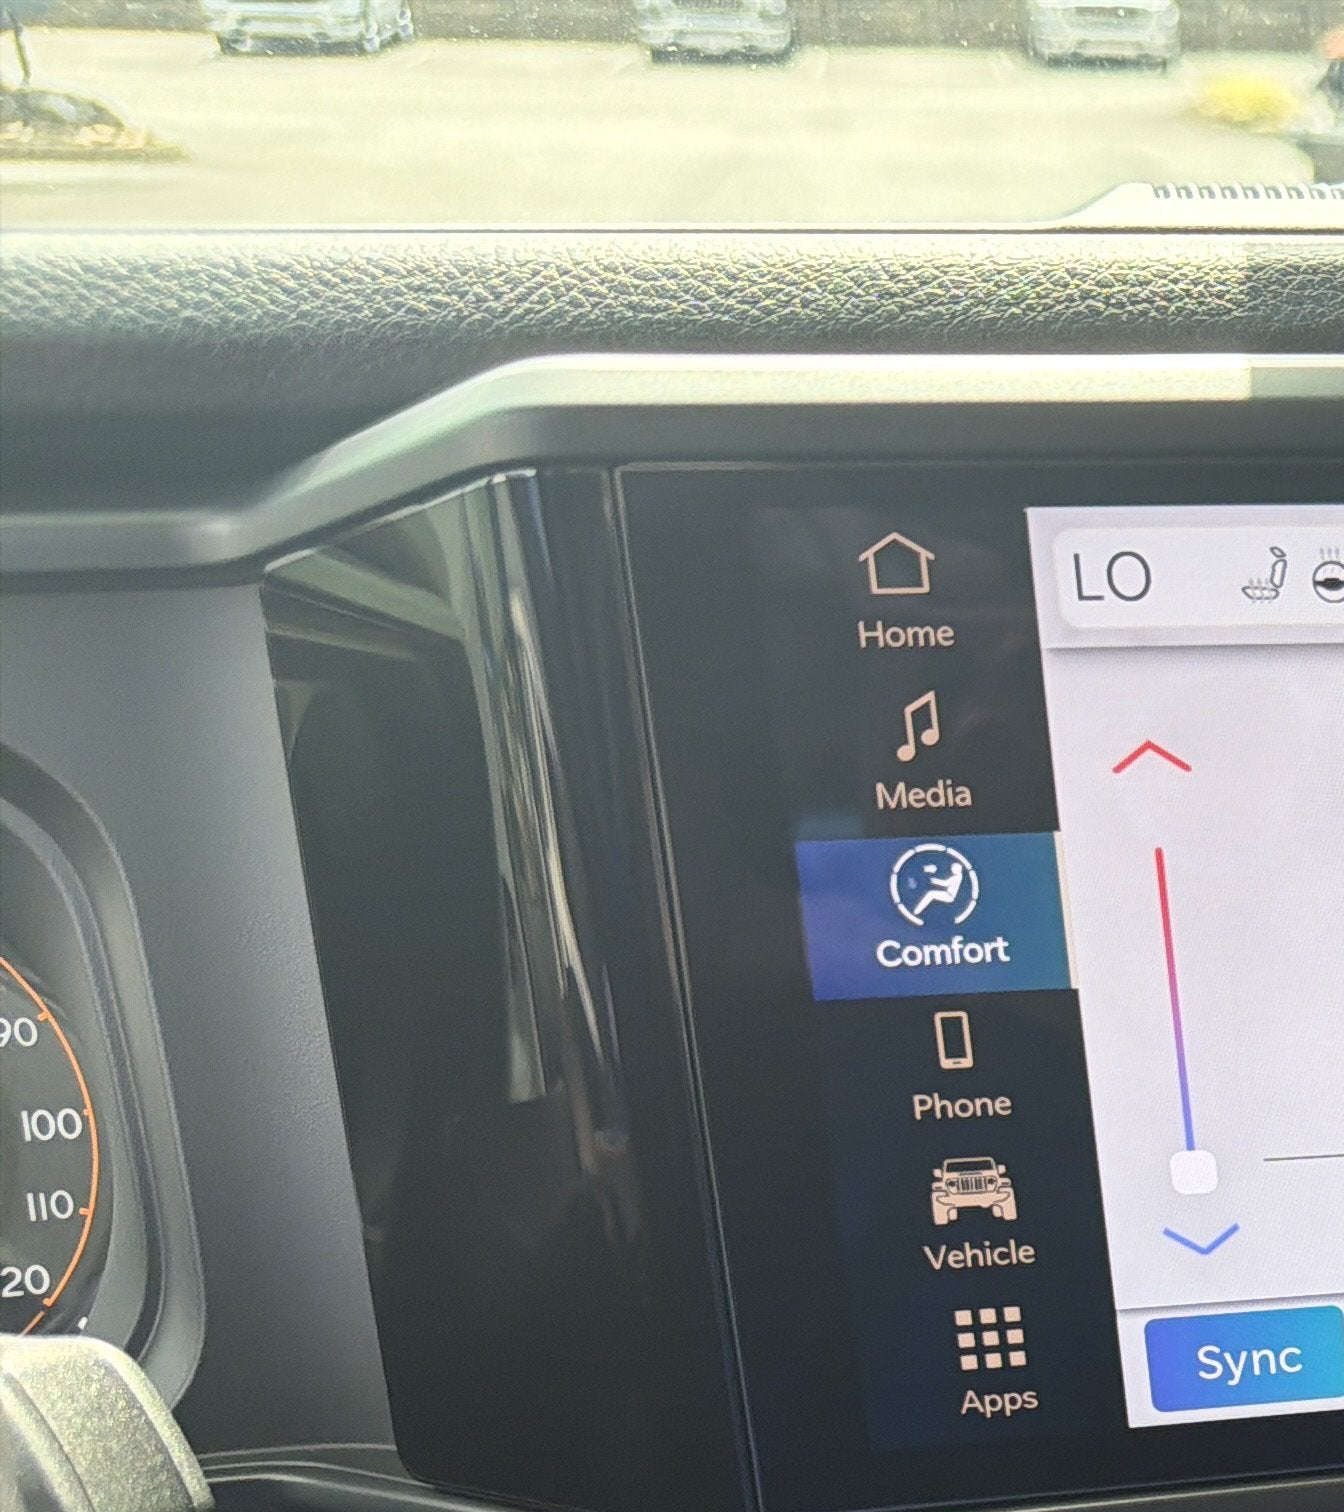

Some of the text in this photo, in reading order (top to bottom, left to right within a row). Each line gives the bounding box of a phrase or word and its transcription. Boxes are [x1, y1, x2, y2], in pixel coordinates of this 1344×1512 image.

[1072, 549, 1152, 603] LO
[858, 619, 955, 650] Home
[875, 779, 973, 811] Media
[876, 934, 1010, 969] Comfort
[912, 1092, 1012, 1121] Phone
[21, 1108, 83, 1142] 100
[27, 1189, 74, 1222] 110
[924, 1239, 1036, 1271] Vehicle
[1197, 1343, 1303, 1385] Sync
[961, 1387, 1039, 1417] Apps
